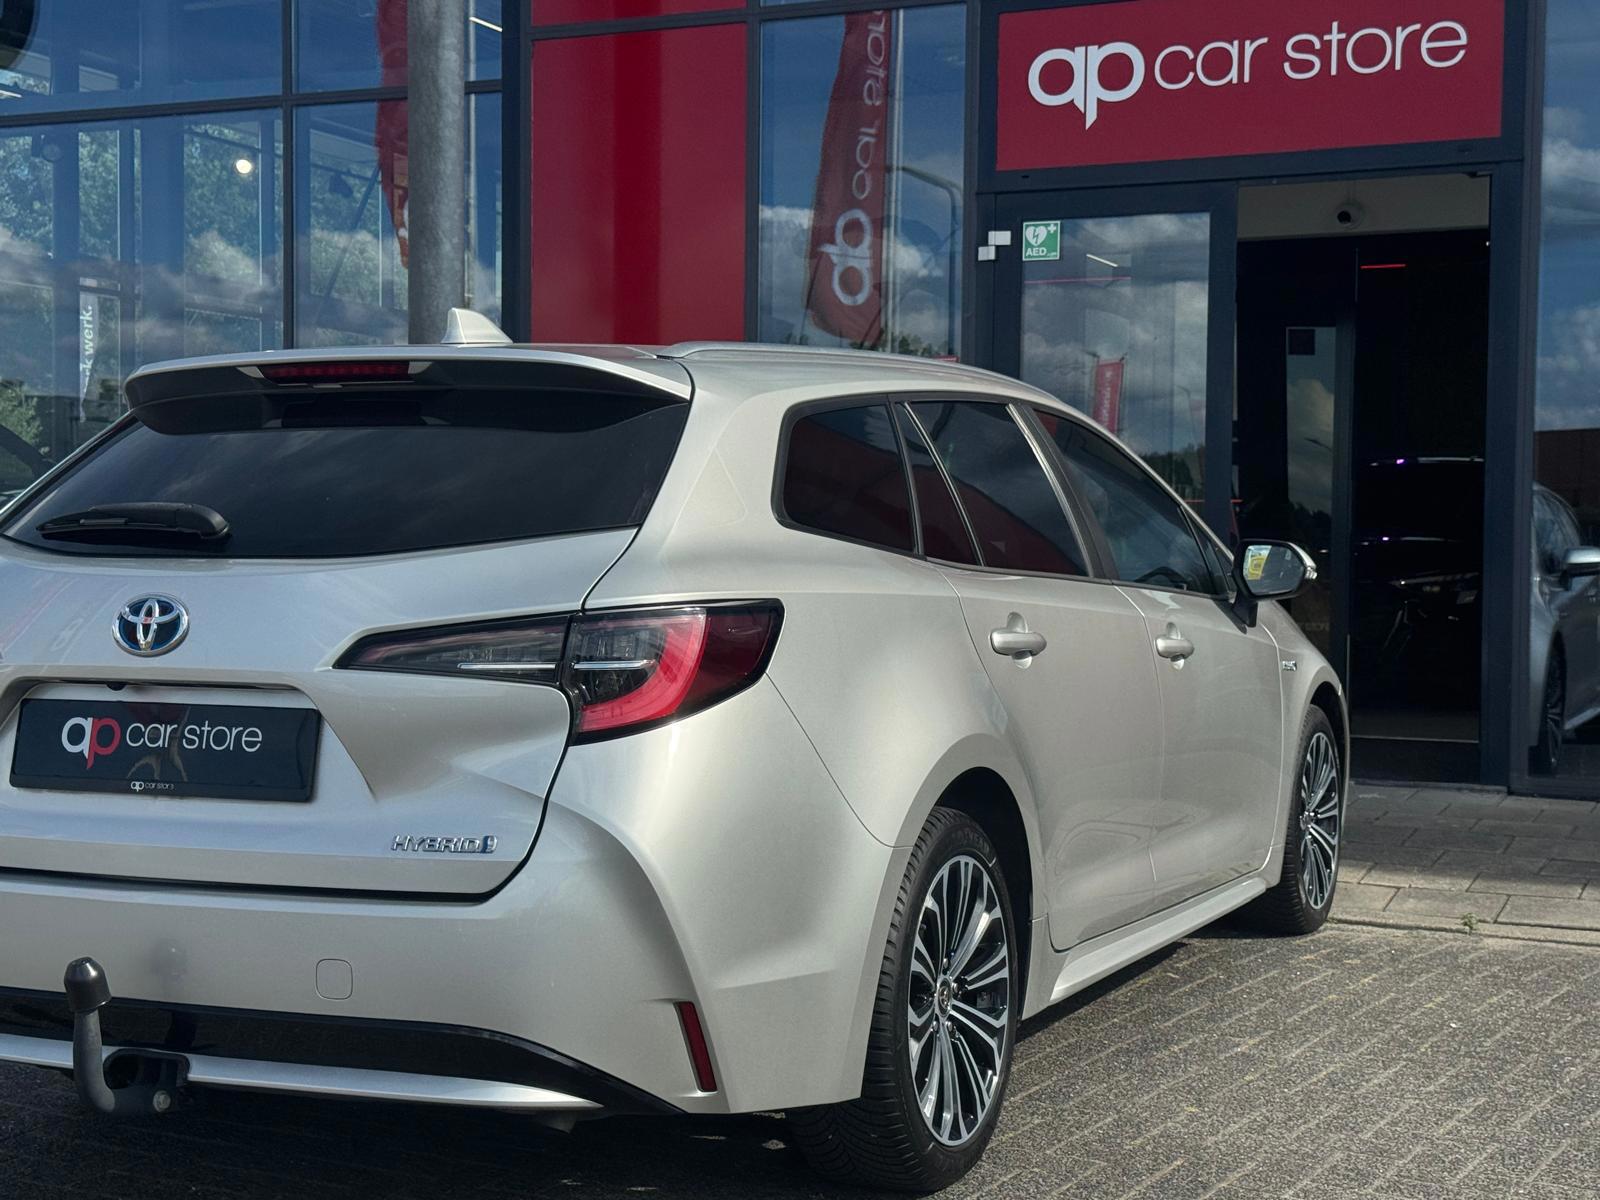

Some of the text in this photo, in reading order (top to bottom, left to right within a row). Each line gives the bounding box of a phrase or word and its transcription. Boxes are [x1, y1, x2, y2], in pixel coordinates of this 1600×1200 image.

[1028, 21, 1468, 130] ap car store
[1026, 247, 1047, 257] AED
[61, 716, 263, 769] ap car store
[391, 834, 481, 854] HYBRID
